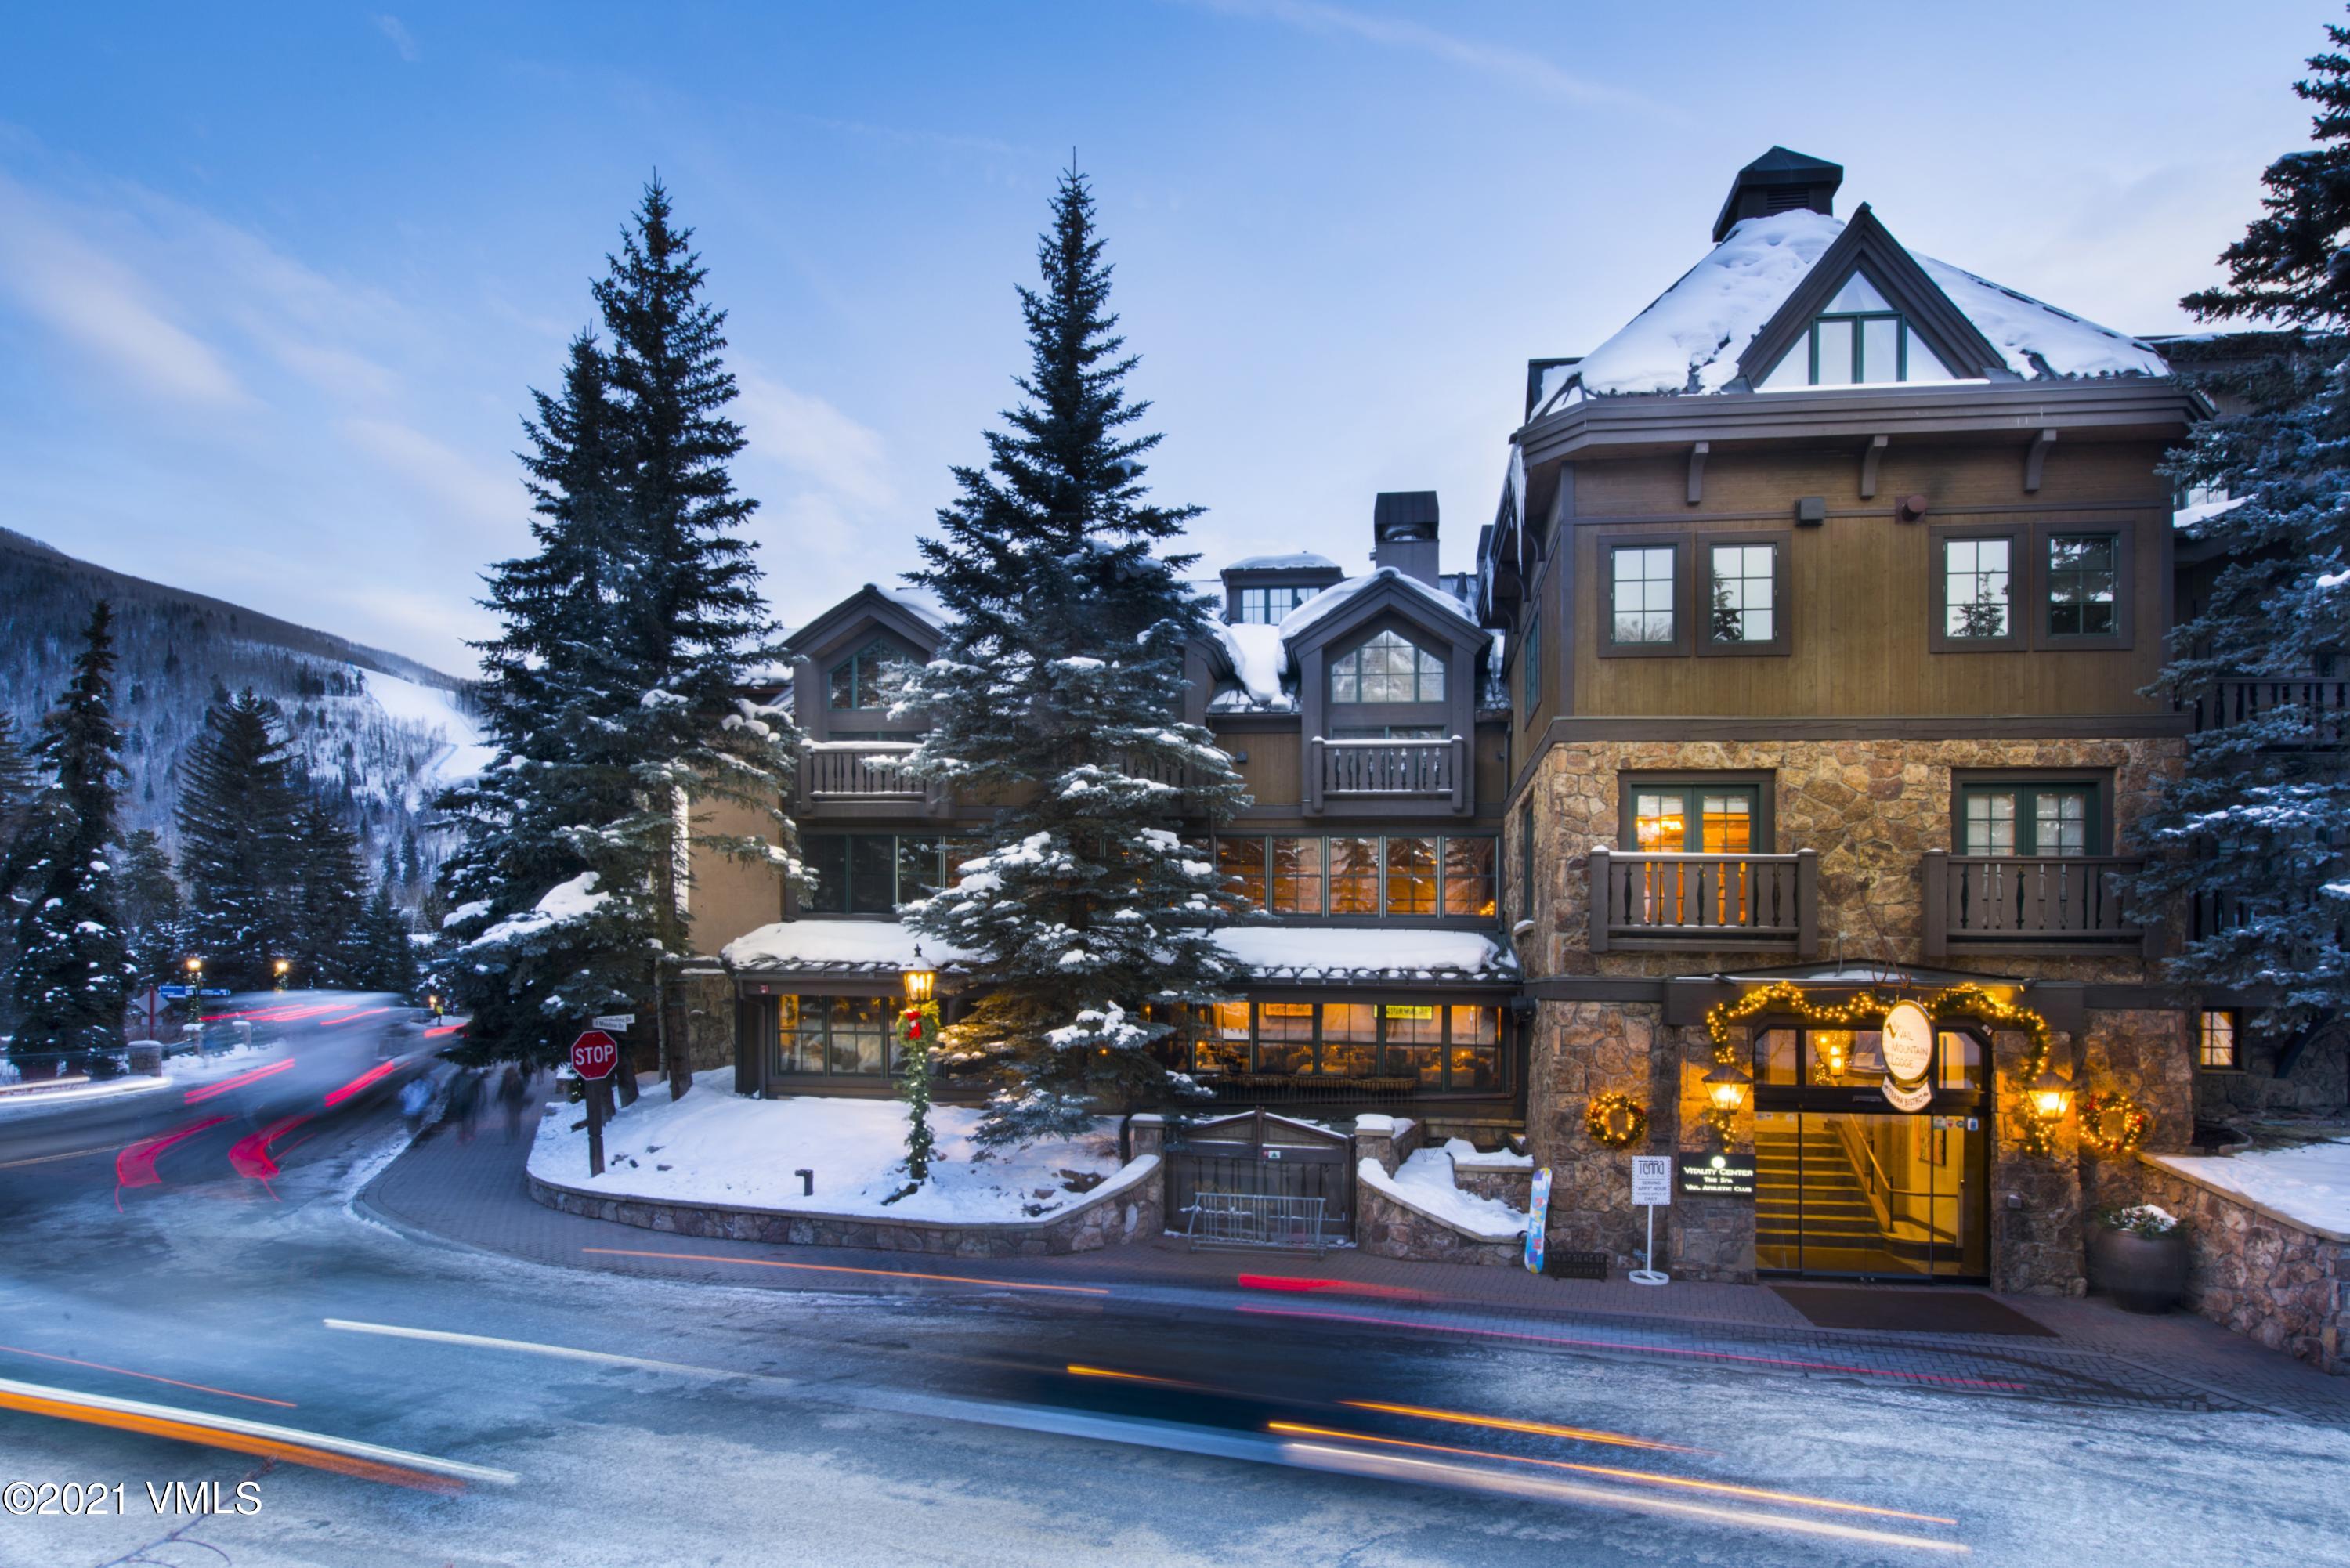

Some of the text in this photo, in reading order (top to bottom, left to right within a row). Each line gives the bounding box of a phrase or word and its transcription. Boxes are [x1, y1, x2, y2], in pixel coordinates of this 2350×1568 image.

[1897, 1026, 1914, 1041] VAIL
[575, 1044, 614, 1065] STOP
[1892, 1042, 1928, 1056] MOUNTAIN
[1891, 1054, 1914, 1068] LODGE
[1887, 1087, 1923, 1106] TERRA BISTRO
[1683, 1166, 1717, 1176] VITALITY
